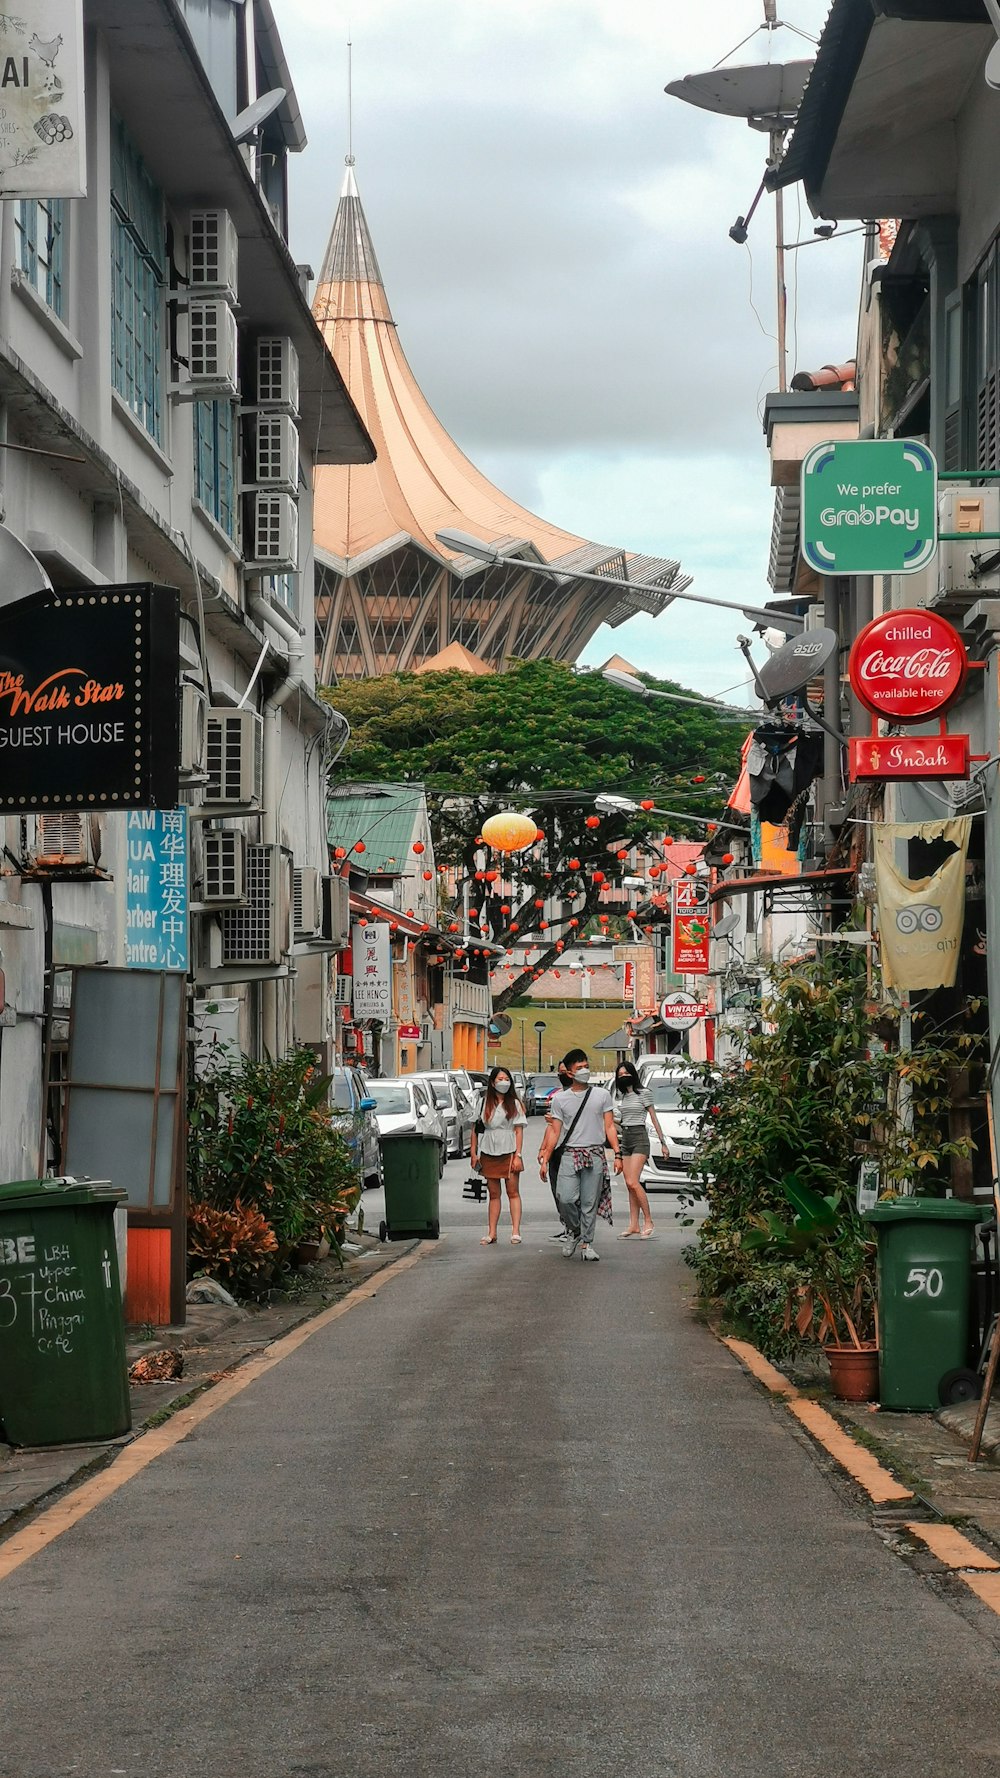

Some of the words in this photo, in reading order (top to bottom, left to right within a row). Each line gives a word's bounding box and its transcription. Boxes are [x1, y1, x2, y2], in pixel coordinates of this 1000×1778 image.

[836, 484, 859, 496] We
[862, 482, 902, 498] prefer
[820, 503, 919, 531] GrabPay
[885, 626, 932, 641] chilled
[793, 643, 823, 657] astro
[0, 668, 88, 717] Walk
[75, 679, 125, 707] Star
[873, 688, 918, 699] available
[920, 688, 944, 698] here
[0, 726, 52, 748] GUEST
[58, 722, 125, 745] HOUSE
[887, 745, 949, 768] Indah
[127, 840, 156, 862] UA
[159, 809, 186, 969] 南华理发中心
[668, 1005, 704, 1013] VINTAGE
[904, 1268, 944, 1297] 50
[44, 1286, 86, 1303] China
